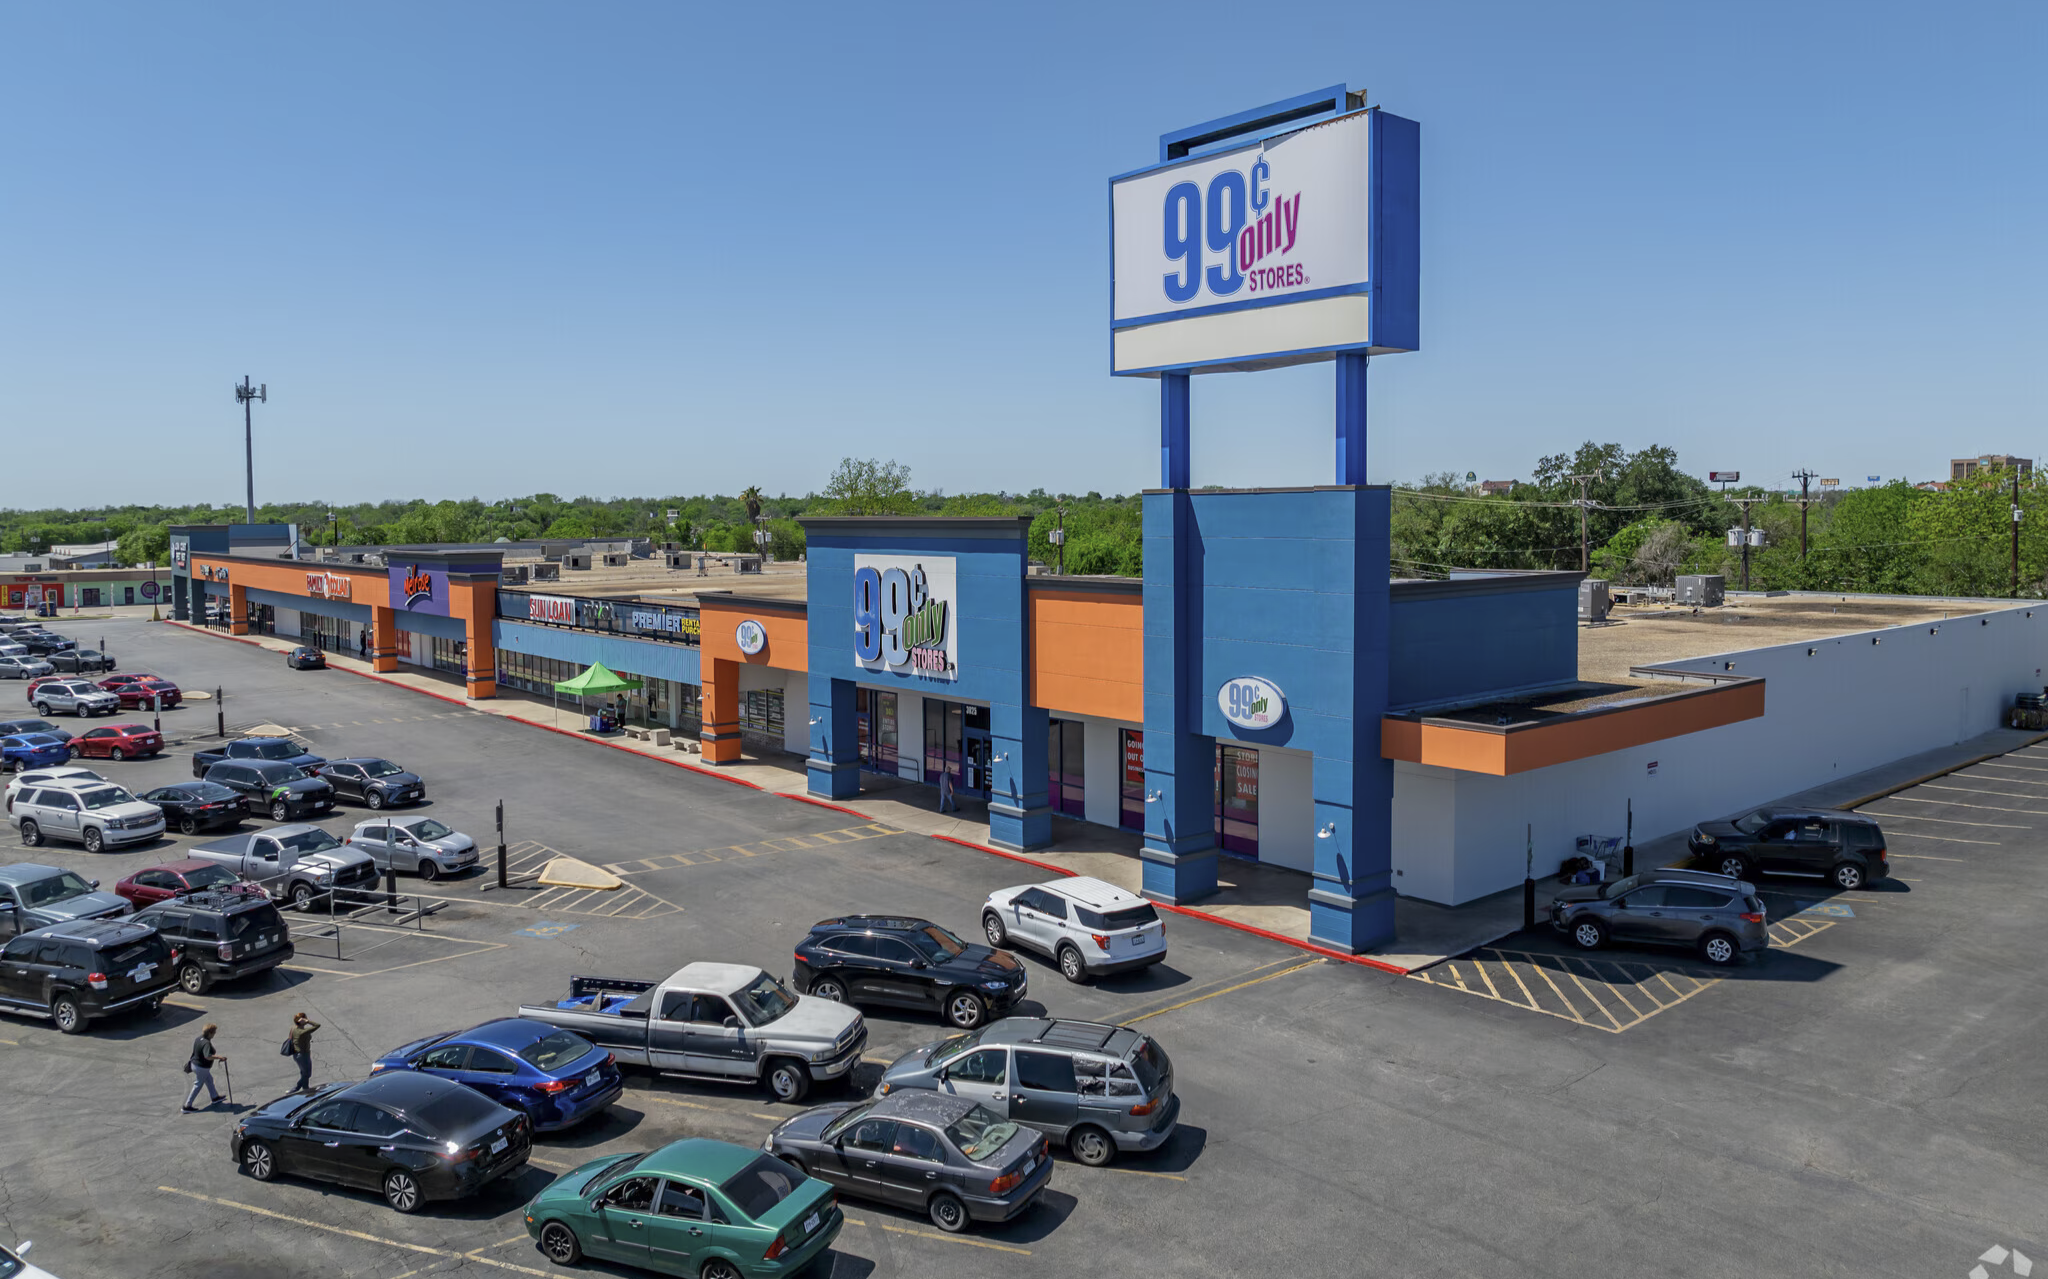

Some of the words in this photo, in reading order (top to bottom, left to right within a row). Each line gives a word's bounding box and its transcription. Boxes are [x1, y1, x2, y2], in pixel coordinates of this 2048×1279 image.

[1240, 191, 1301, 272] only
[530, 599, 546, 618] SUN
[548, 600, 570, 621] LOAN
[632, 611, 681, 632] PREMIER
[682, 619, 700, 628] RENTA
[903, 599, 946, 651] only
[911, 647, 945, 672] STORES
[1251, 697, 1268, 715] only
[1128, 752, 1138, 761] OUT
[1238, 782, 1257, 795] SALE
